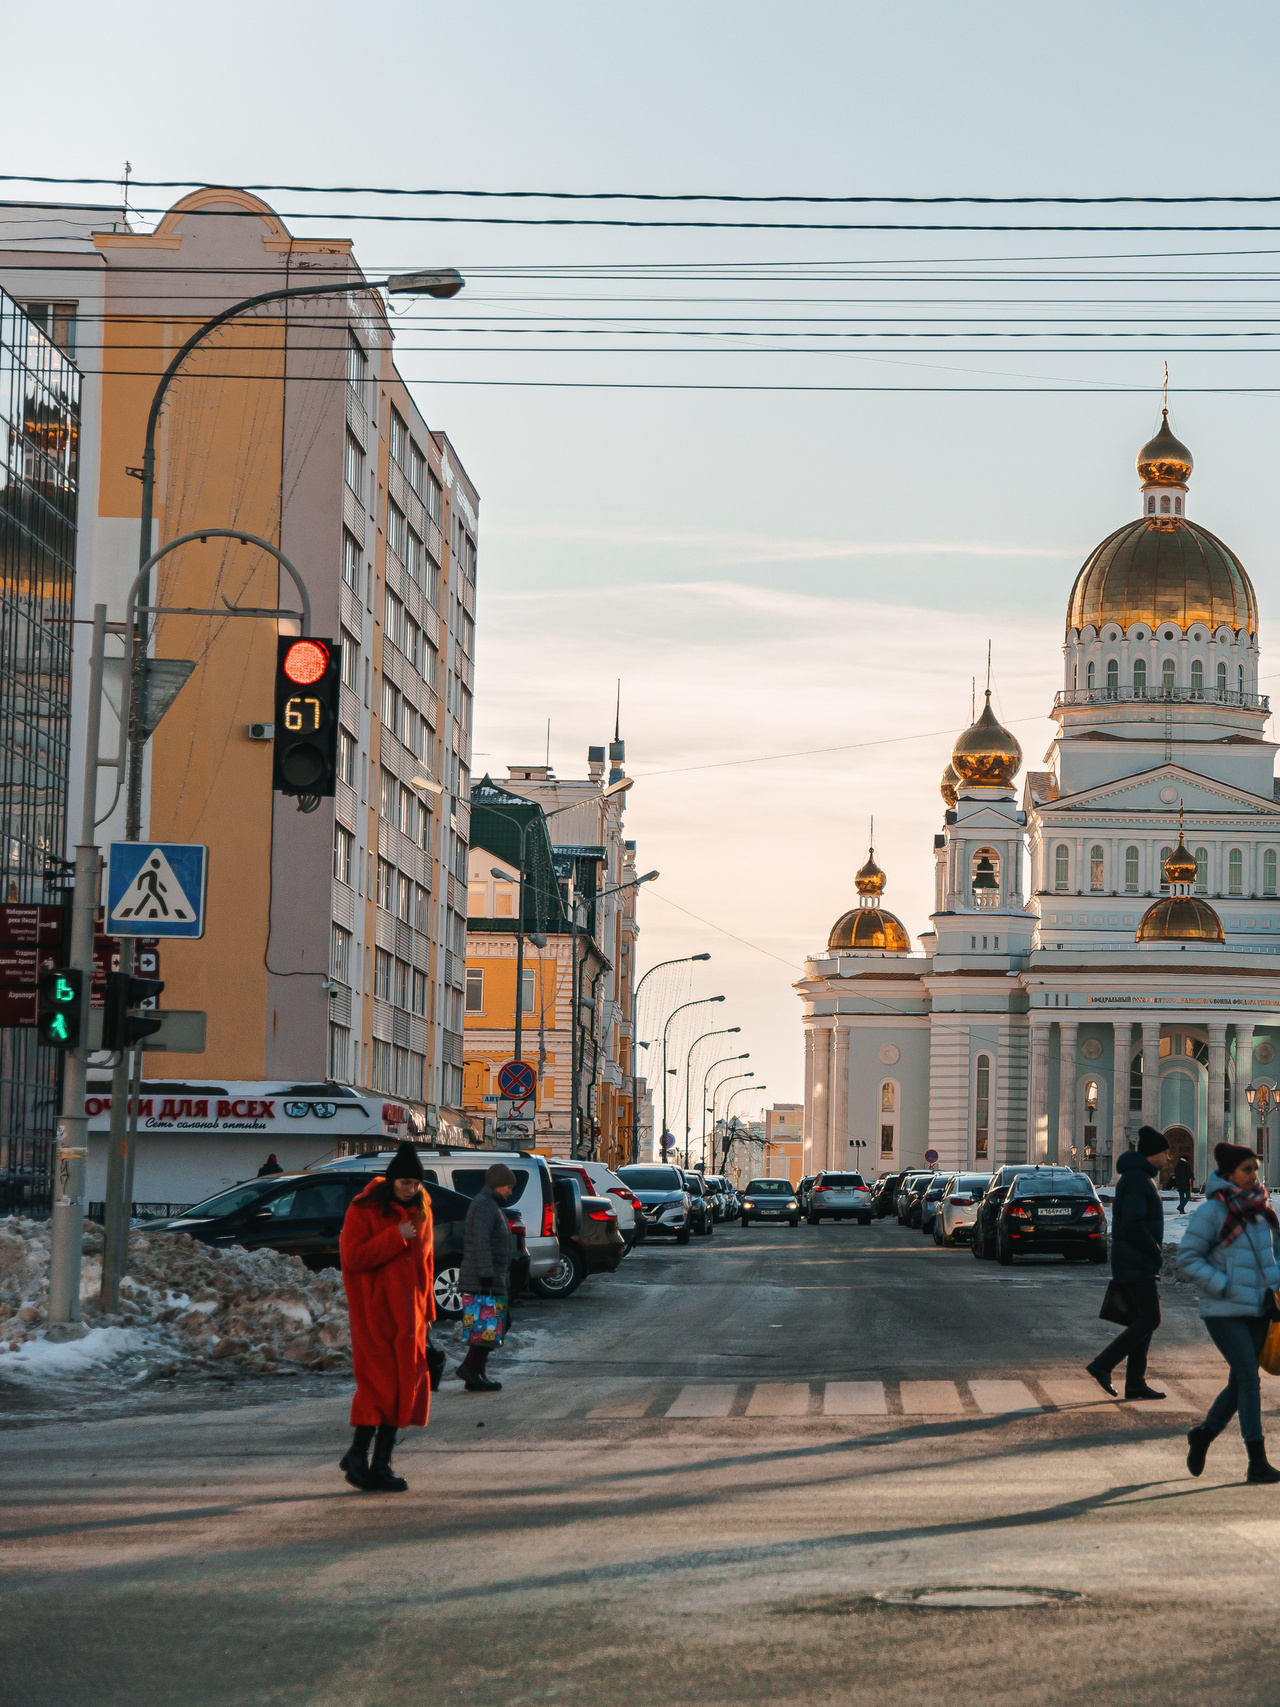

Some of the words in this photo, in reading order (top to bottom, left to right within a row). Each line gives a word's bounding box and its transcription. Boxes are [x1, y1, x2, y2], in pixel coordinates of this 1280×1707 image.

[285, 698, 320, 730] 67
[8, 991, 36, 999] Аэропорт
[159, 1098, 209, 1120] ДЛЯ
[217, 1098, 276, 1119] ВСЕХ
[145, 1117, 174, 1129] Сеть
[176, 1118, 220, 1130] салонов
[222, 1118, 267, 1130] оптики
